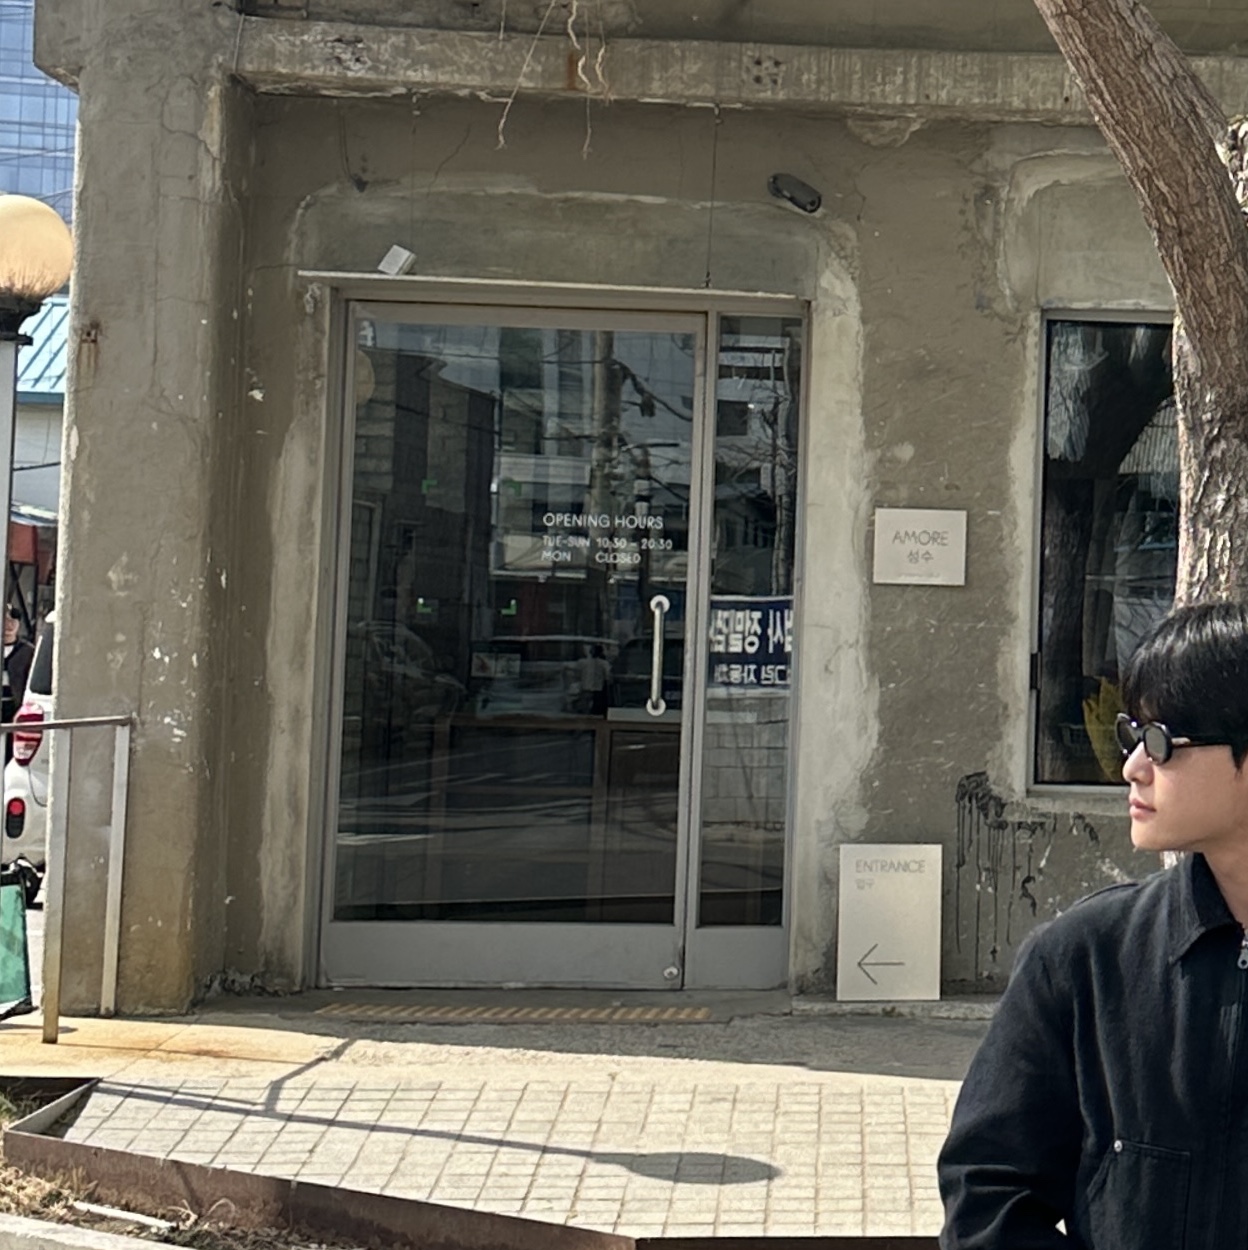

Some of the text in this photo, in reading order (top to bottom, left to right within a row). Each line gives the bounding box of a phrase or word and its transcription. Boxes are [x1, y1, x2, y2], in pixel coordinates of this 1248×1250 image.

[543, 512, 663, 529] OPENING HOURS
[543, 535, 590, 547] TUE-SUN
[892, 530, 949, 546] AMORE
[541, 550, 641, 563] MON CLOSED
[906, 549, 934, 564] 성수
[855, 859, 926, 873] ENTRANCE
